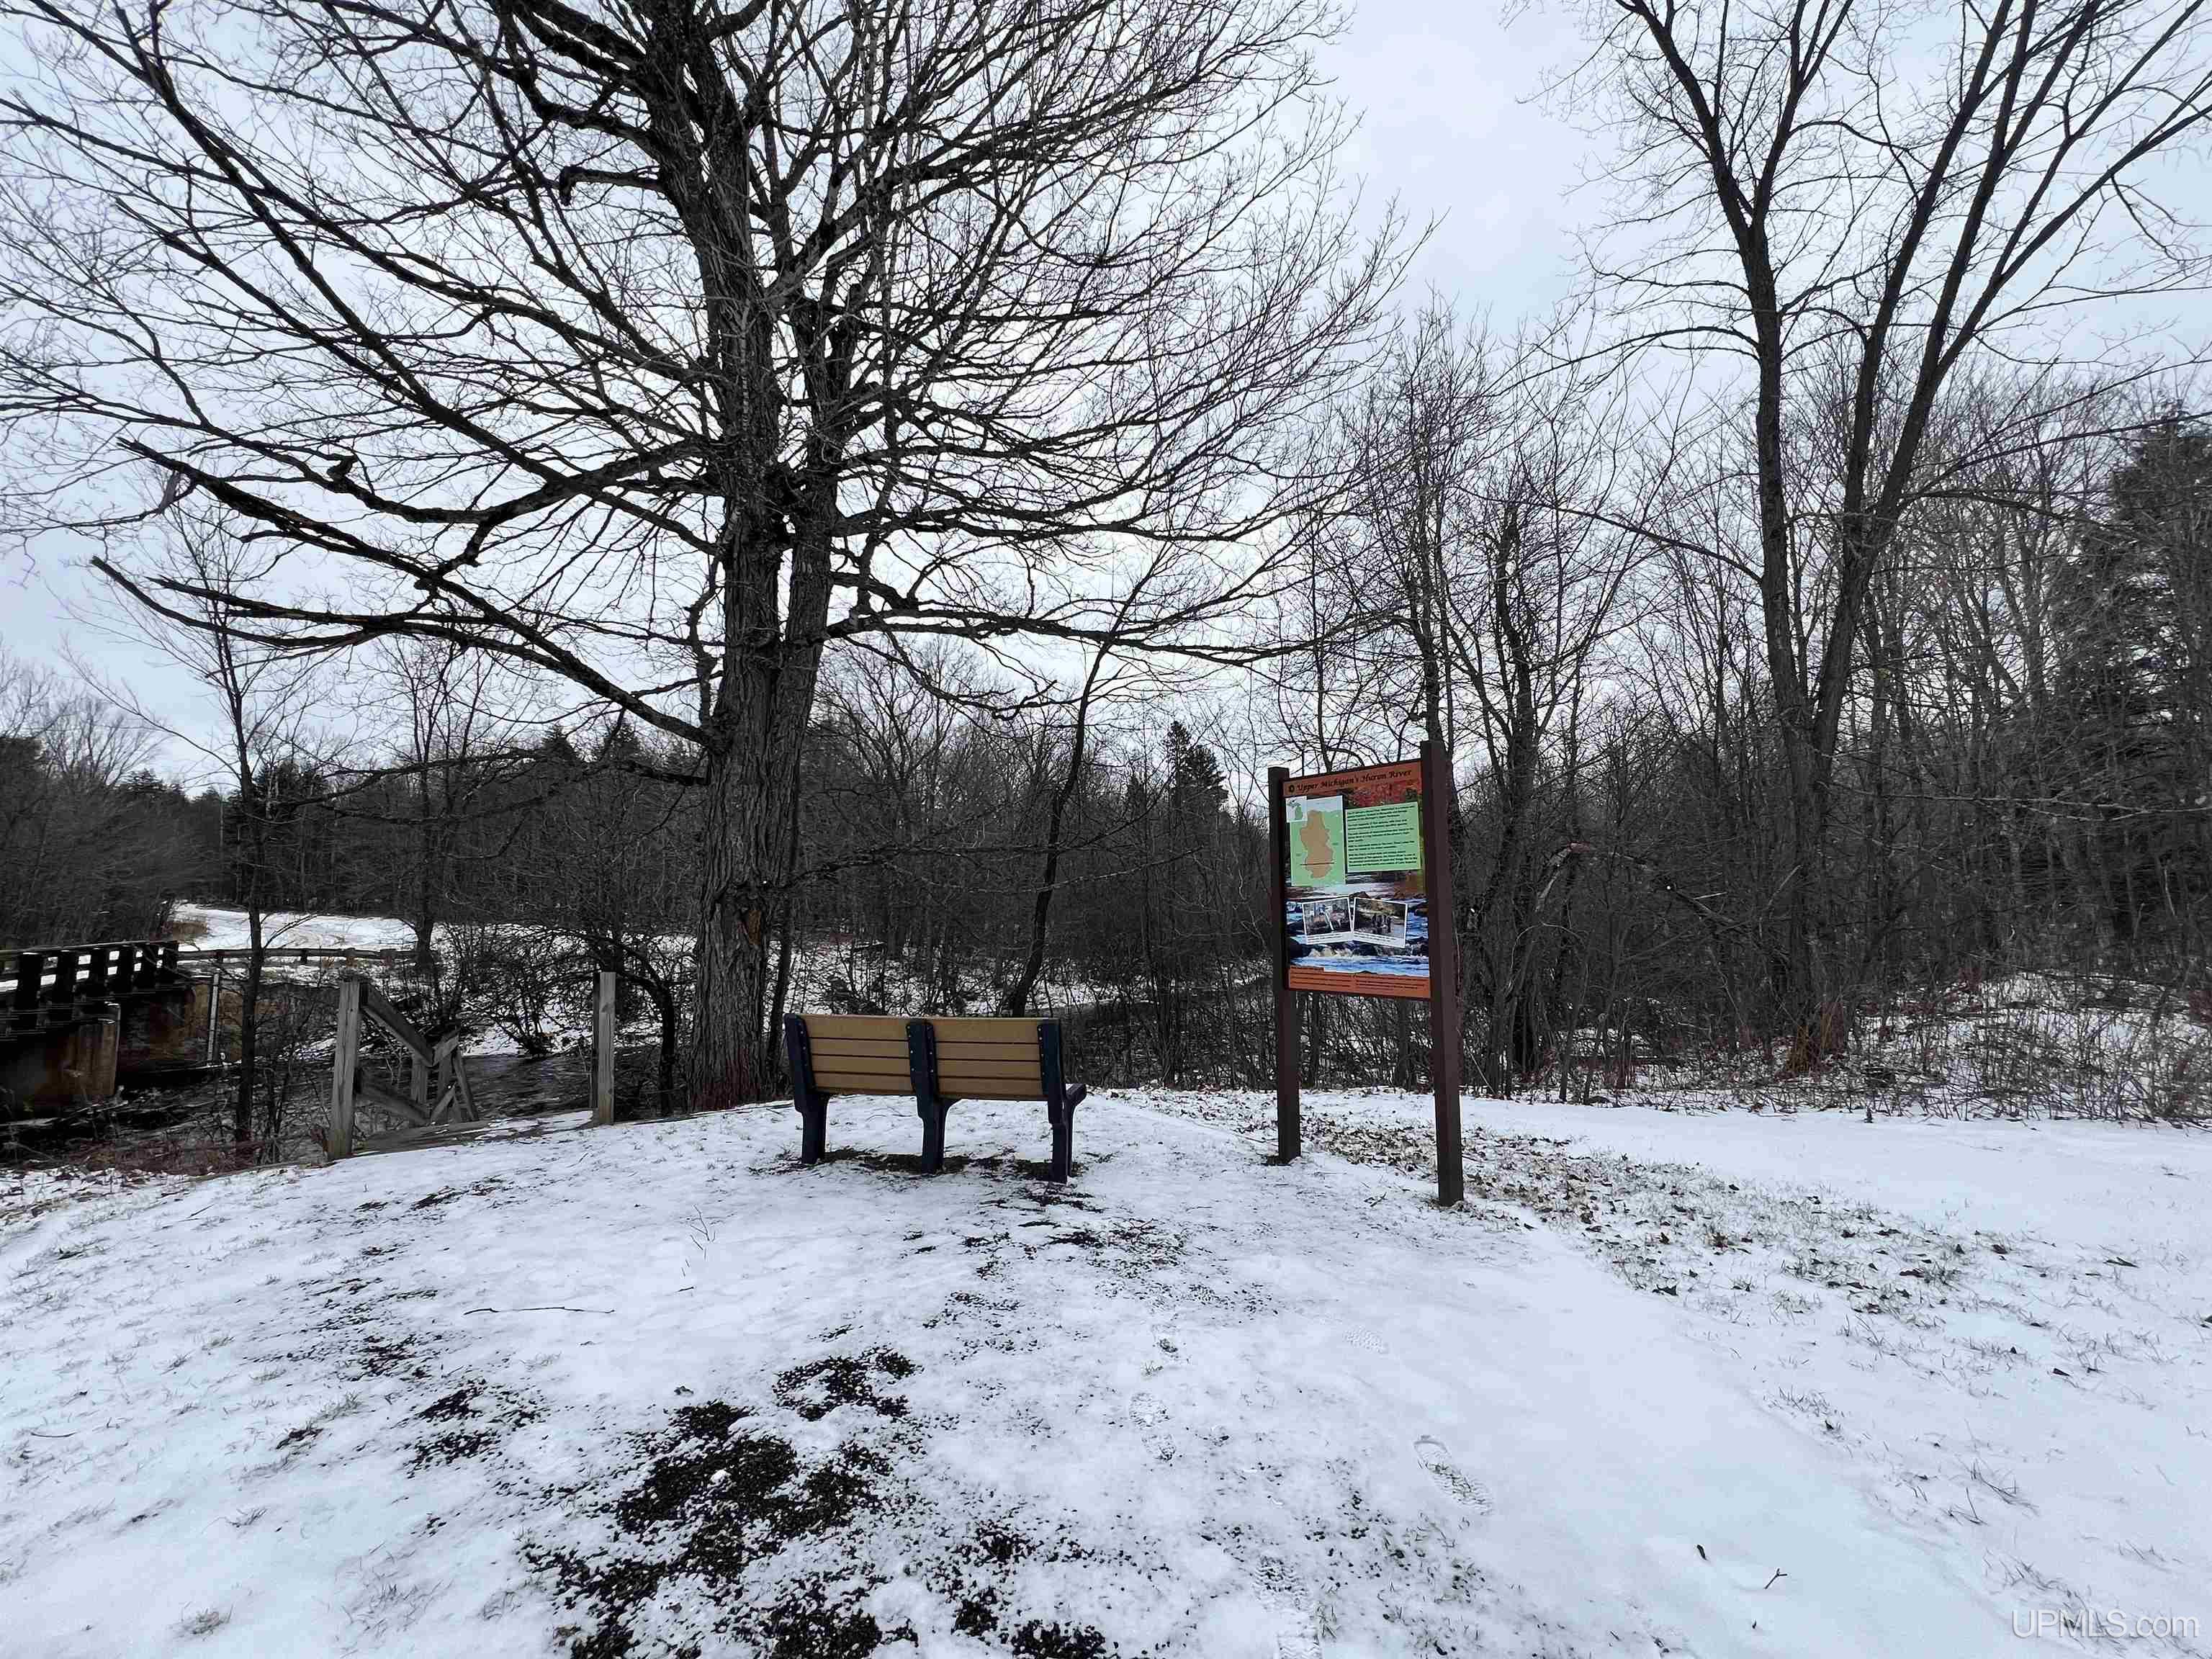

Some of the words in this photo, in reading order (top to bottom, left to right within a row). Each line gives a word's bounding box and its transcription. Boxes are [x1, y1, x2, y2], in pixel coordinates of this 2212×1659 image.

[1297, 783, 1318, 793] Upper
[1320, 775, 1359, 788] Michigan's
[1360, 773, 1387, 783] Huron
[1389, 770, 1411, 778] River
